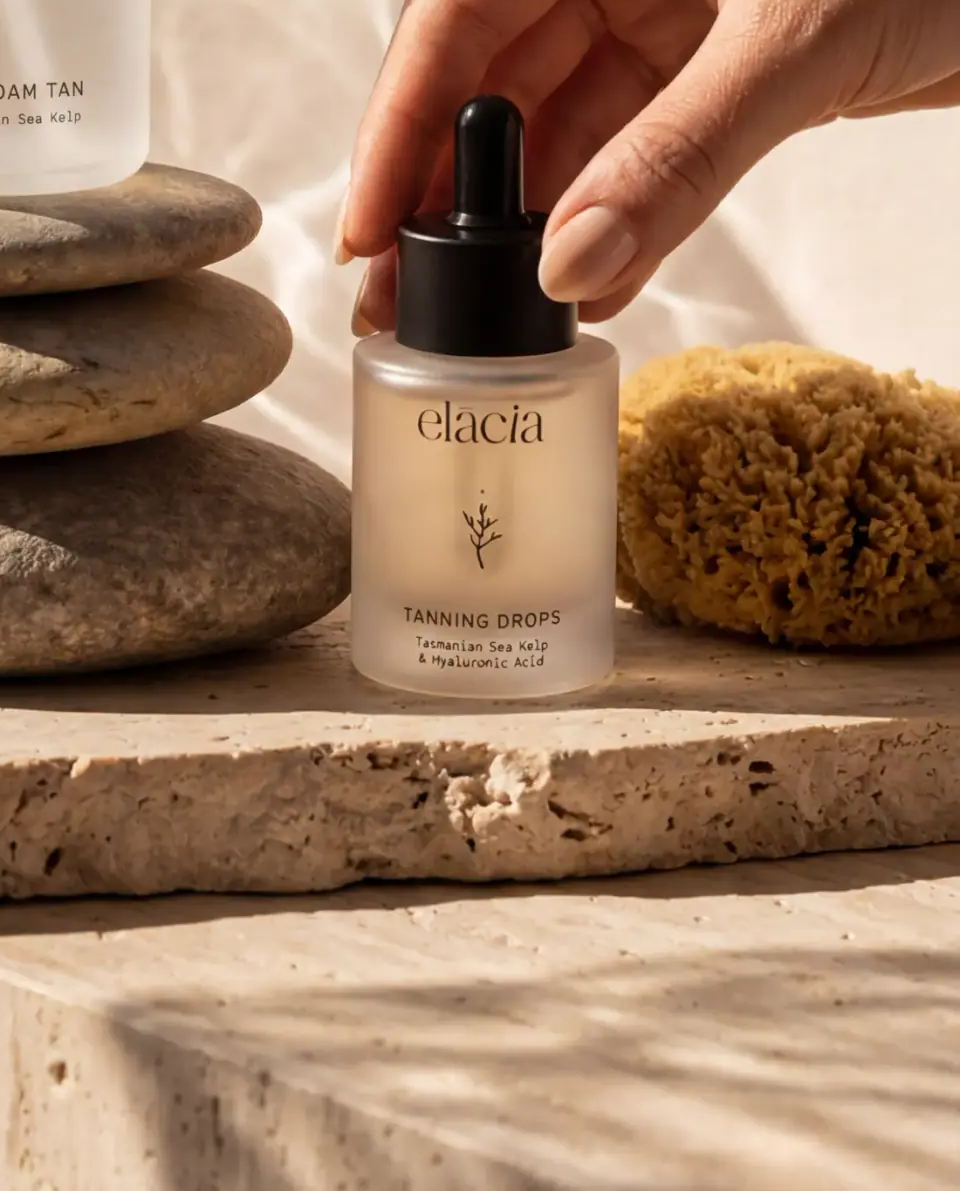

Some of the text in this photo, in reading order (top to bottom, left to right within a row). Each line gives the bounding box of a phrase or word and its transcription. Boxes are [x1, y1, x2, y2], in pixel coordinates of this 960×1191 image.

[46, 80, 84, 98] TAN
[18, 113, 43, 125] Sea
[50, 110, 82, 125] Kelp
[417, 400, 544, 444] elācia
[403, 607, 561, 629] TANNING DROPS
[416, 636, 549, 652] Tasmanian Sea Kelp
[418, 653, 544, 669] & Hyaluronic Acid
